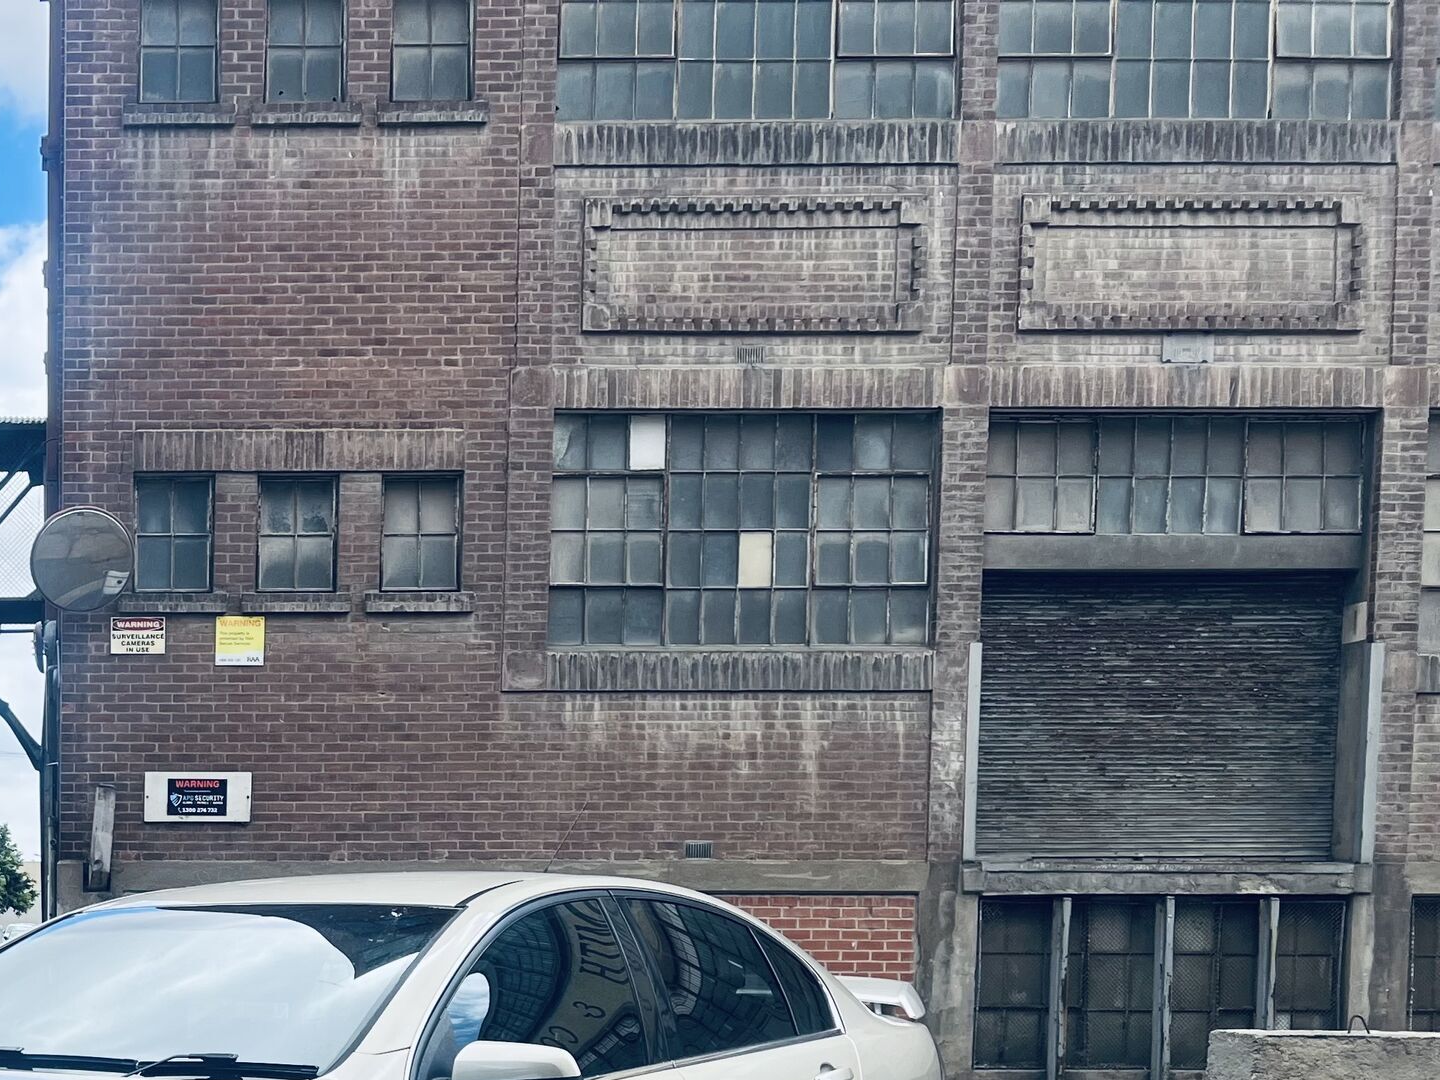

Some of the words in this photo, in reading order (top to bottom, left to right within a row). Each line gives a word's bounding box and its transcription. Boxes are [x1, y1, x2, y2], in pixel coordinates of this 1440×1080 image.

[116, 620, 160, 628] WARNING
[219, 619, 261, 627] WARNING
[175, 780, 220, 788] WARNING
